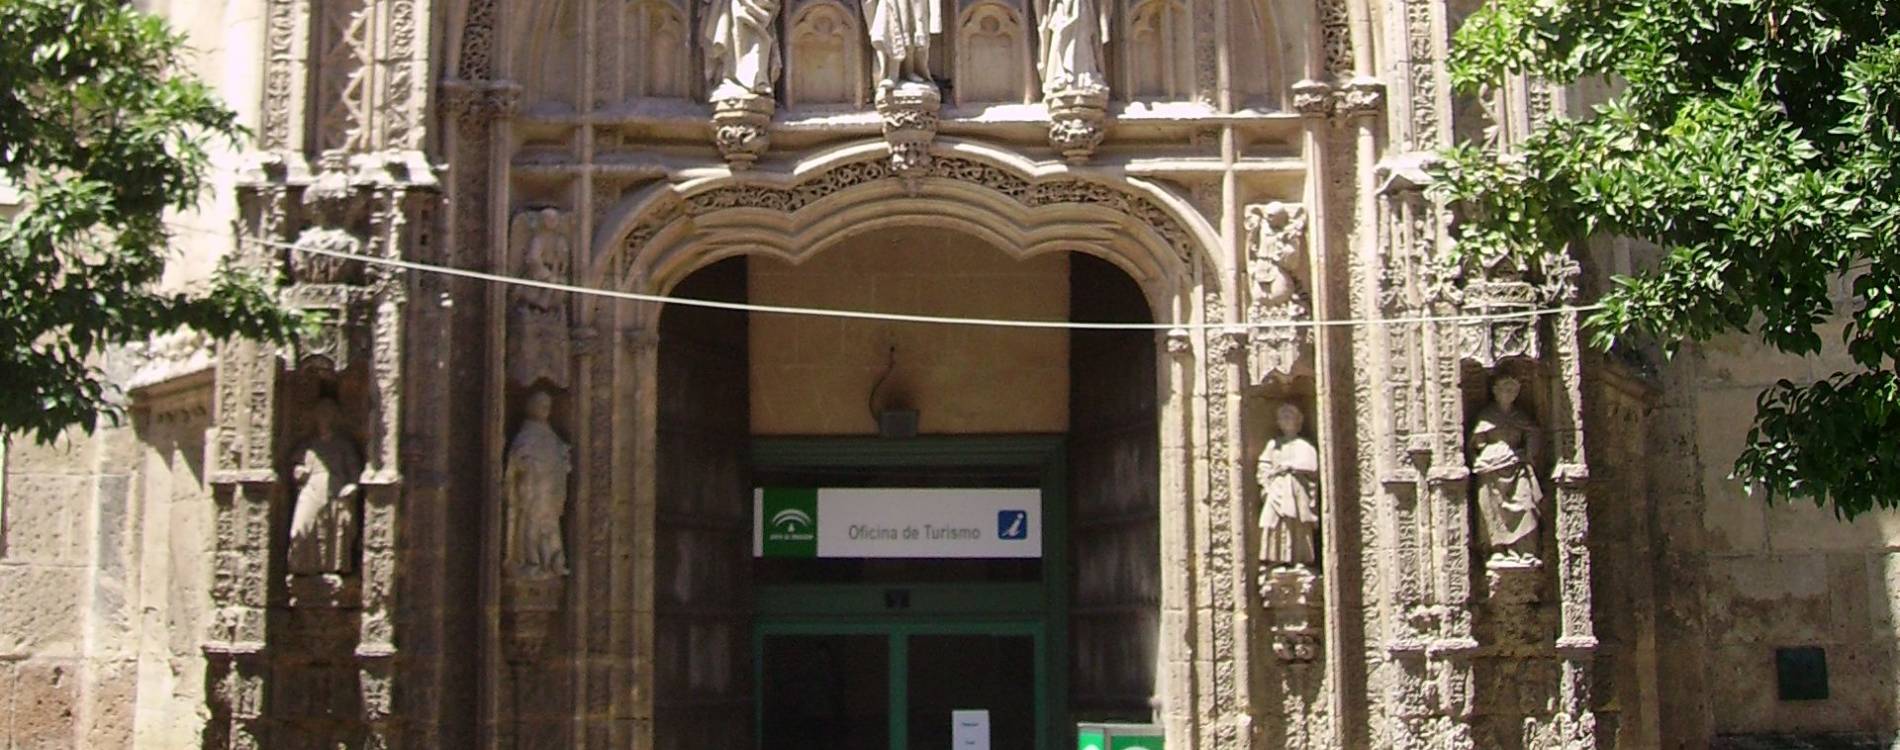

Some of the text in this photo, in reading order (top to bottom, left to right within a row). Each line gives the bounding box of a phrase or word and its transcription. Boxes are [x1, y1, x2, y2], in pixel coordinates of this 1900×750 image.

[848, 523, 981, 541] Oficina de Turismo
